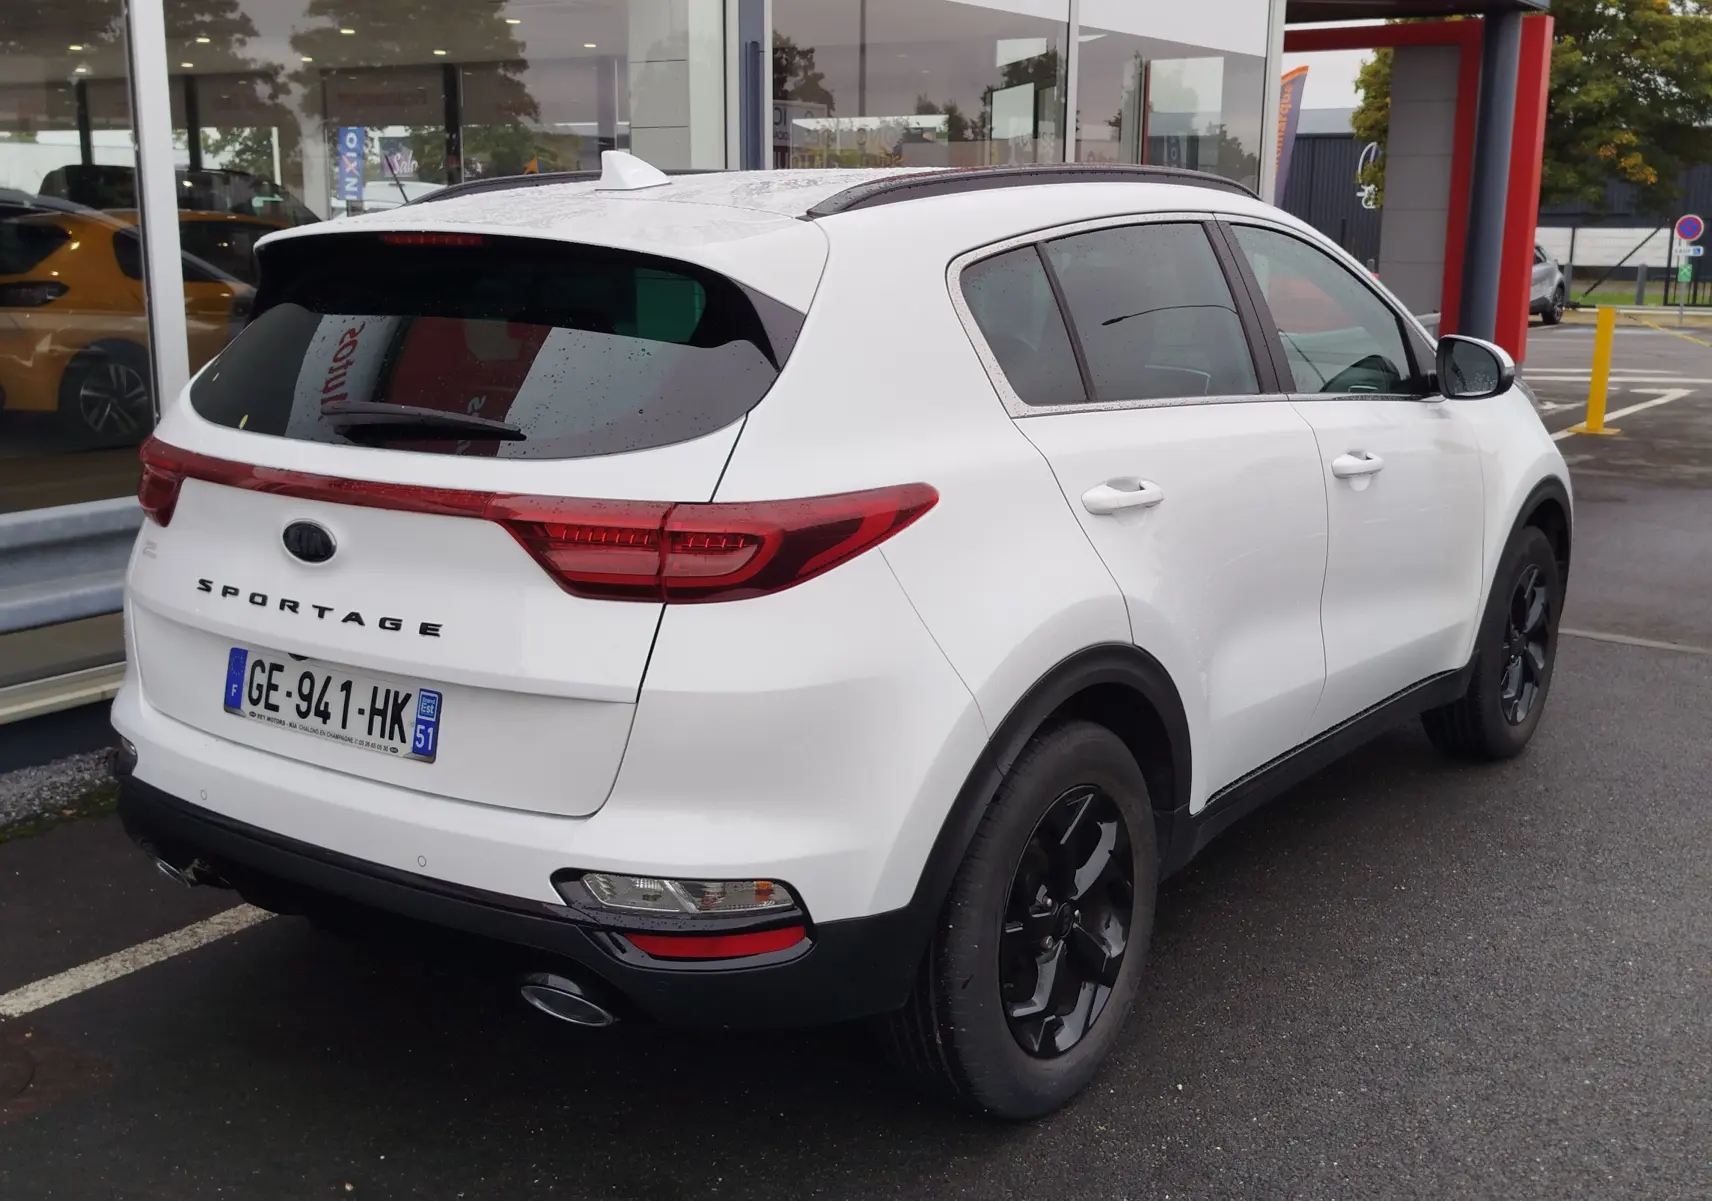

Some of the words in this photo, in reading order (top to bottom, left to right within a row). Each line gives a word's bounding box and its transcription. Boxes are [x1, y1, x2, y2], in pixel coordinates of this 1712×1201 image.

[197, 578, 444, 638] SPORTAGE
[230, 684, 238, 697] F
[247, 659, 412, 744] GE-941-HK
[421, 703, 435, 714] Est
[415, 724, 434, 751] 51
